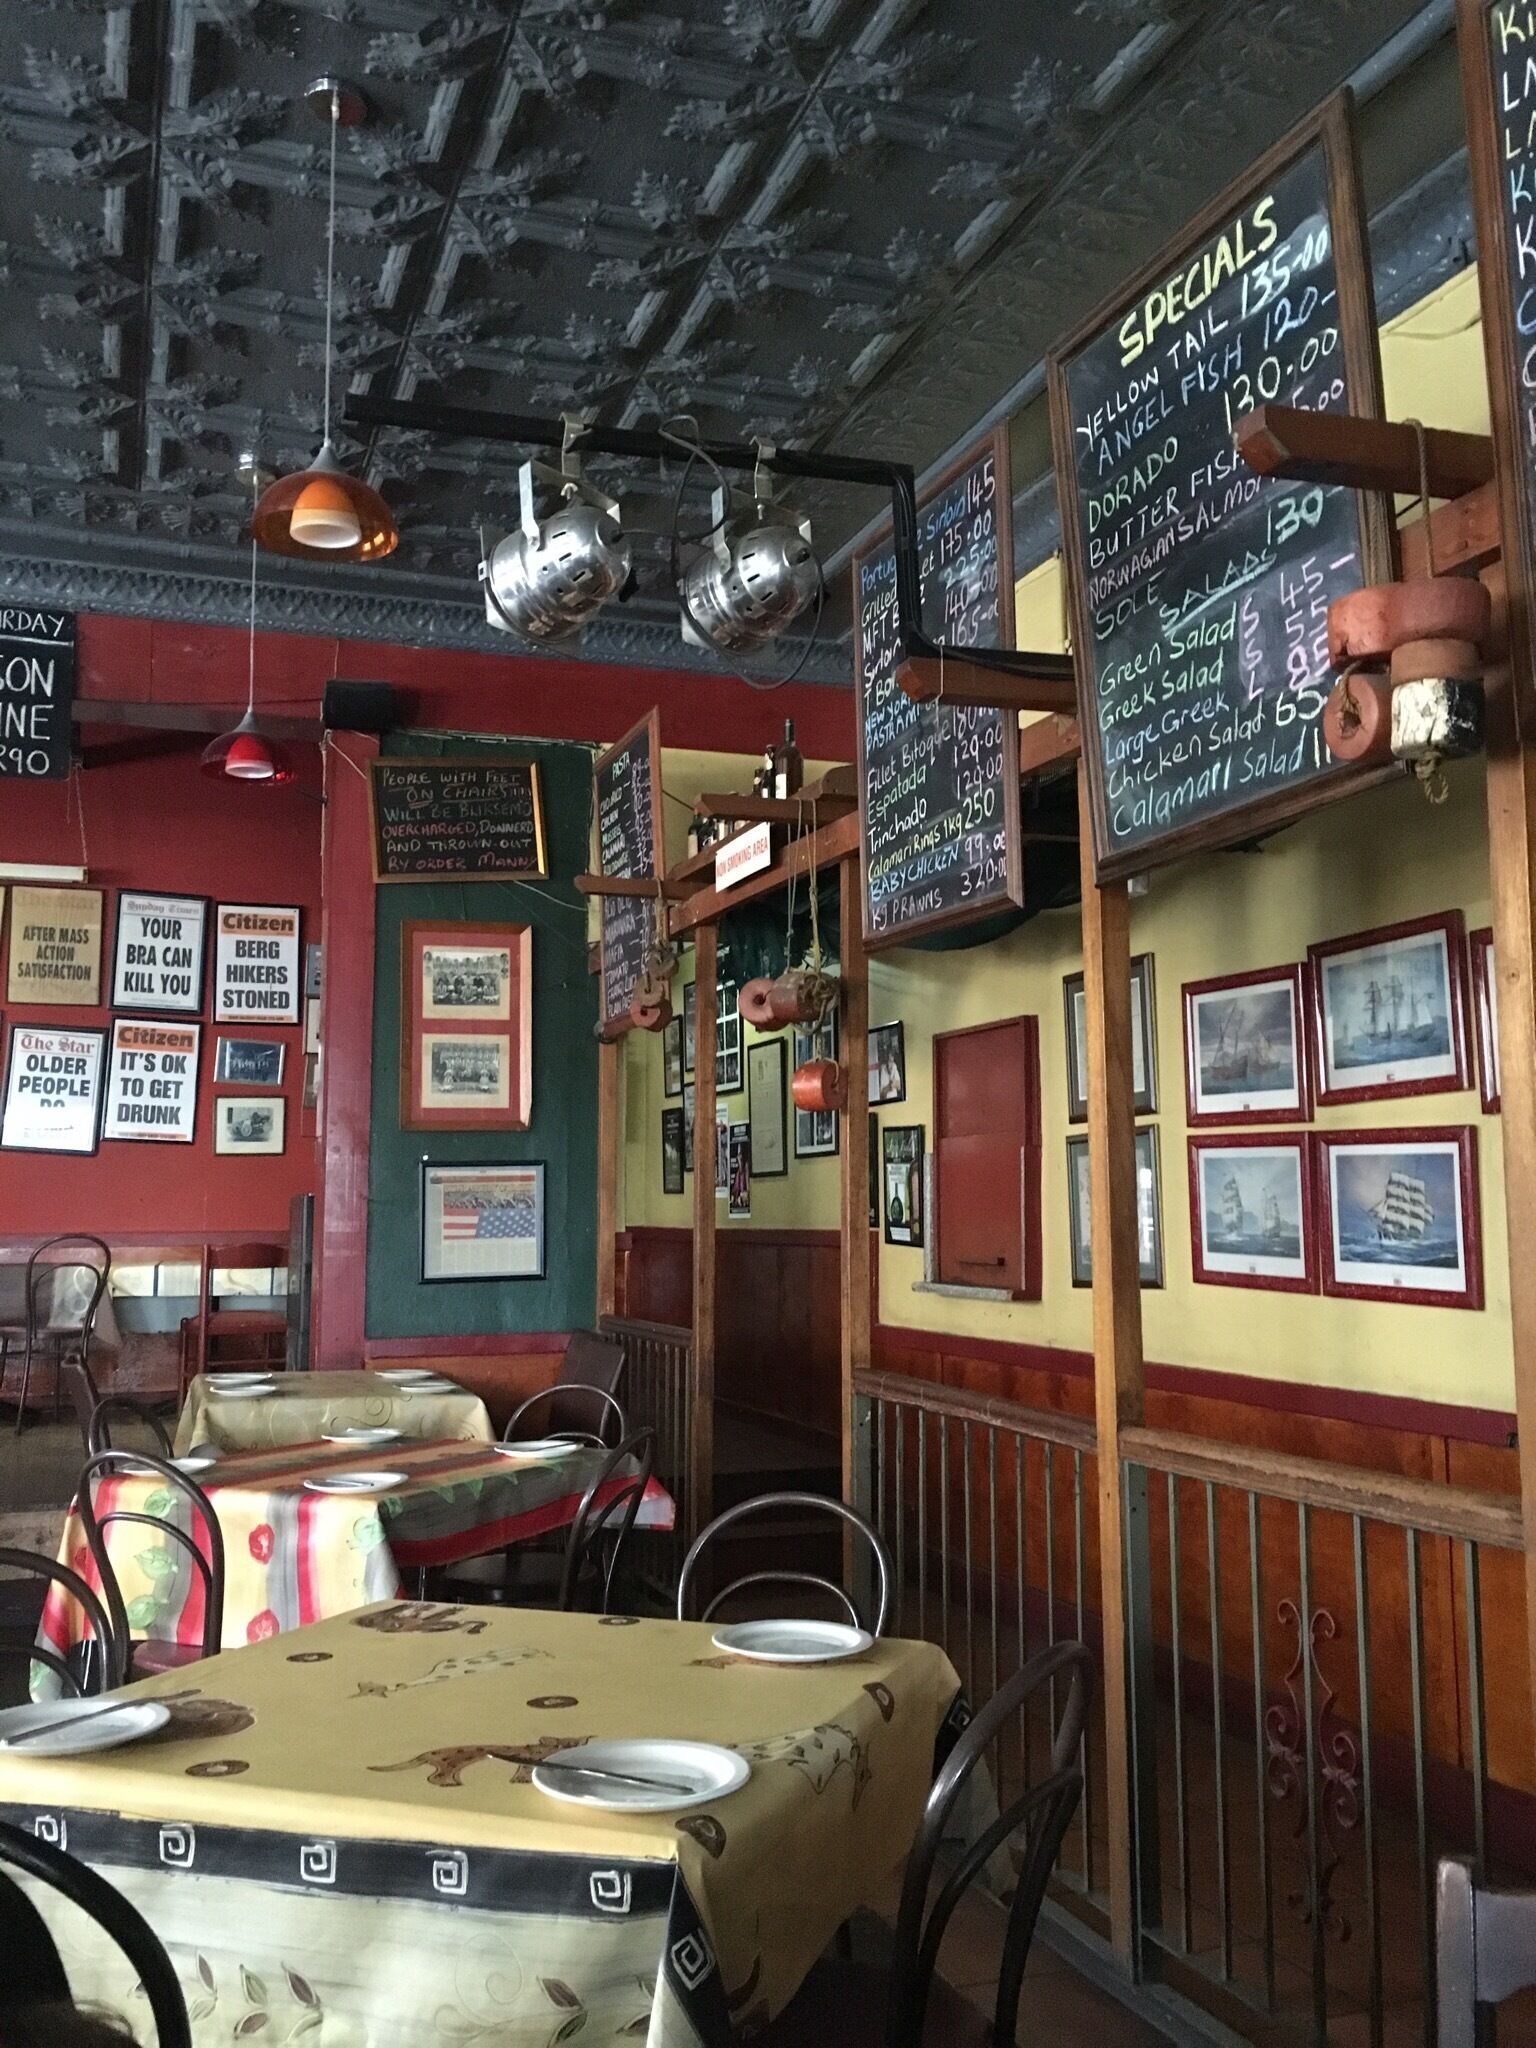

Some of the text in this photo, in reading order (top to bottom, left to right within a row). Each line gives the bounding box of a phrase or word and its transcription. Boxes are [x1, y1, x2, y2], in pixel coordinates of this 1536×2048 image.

[1118, 195, 1278, 367] SPECIALS
[1076, 366, 1159, 452] YELLOW
[1166, 308, 1229, 369] TAIL
[1099, 389, 1174, 476] ANGEL
[1181, 332, 1242, 406] FISH
[1089, 436, 1178, 533] DORADO
[926, 494, 966, 542] Sirloin
[967, 458, 996, 513] 145
[1090, 486, 1180, 569] BUTTER
[1096, 567, 1167, 640] SOLE
[1159, 549, 1276, 633] SALADS
[862, 586, 897, 628] Grilled
[1100, 642, 1161, 696] Green
[1169, 601, 1237, 660] Salad
[1100, 683, 1156, 731] Greek
[1162, 646, 1224, 701] Salad
[866, 707, 885, 737] NEW
[866, 703, 920, 761] PASTRAMI
[1106, 724, 1160, 764] Large
[1162, 691, 1230, 735] Greek
[867, 755, 897, 800] Fillet
[902, 719, 951, 768] Bitoque
[1109, 734, 1202, 799] Chicken
[1209, 697, 1266, 752] Salad
[383, 768, 431, 787] PEOPLE
[486, 770, 521, 783] FEET
[868, 760, 926, 825] Espatada
[1113, 756, 1231, 836] Calamari
[1239, 725, 1307, 783] Salad
[407, 787, 434, 800] ON
[867, 796, 927, 855] Trinchado
[868, 842, 912, 883] Calamari
[914, 825, 941, 854] Rings
[963, 787, 996, 829] 250
[387, 840, 421, 853] AND
[727, 844, 752, 872] SMOKING
[752, 835, 769, 857] AREA
[870, 867, 906, 902] BABY
[127, 901, 165, 914] Sunday
[223, 912, 294, 932] Citizen
[23, 926, 90, 944] AFTER MASS
[141, 917, 182, 940] YOUR
[36, 944, 75, 961] ACTION
[126, 943, 192, 968] BRA CAN
[235, 940, 280, 959] BERG
[17, 962, 91, 981] SATISFACTION
[123, 971, 191, 996] KILL YOU
[226, 964, 288, 985] HIKERS
[222, 989, 290, 1009] STONED
[21, 1033, 96, 1054] The Star
[118, 1026, 194, 1048] Citizen
[26, 1054, 87, 1076] OLDER
[120, 1051, 187, 1074] IT'S OK
[18, 1075, 91, 1097] PEOPLE
[120, 1077, 183, 1100] TO GET
[117, 1103, 181, 1125] DRUNK
